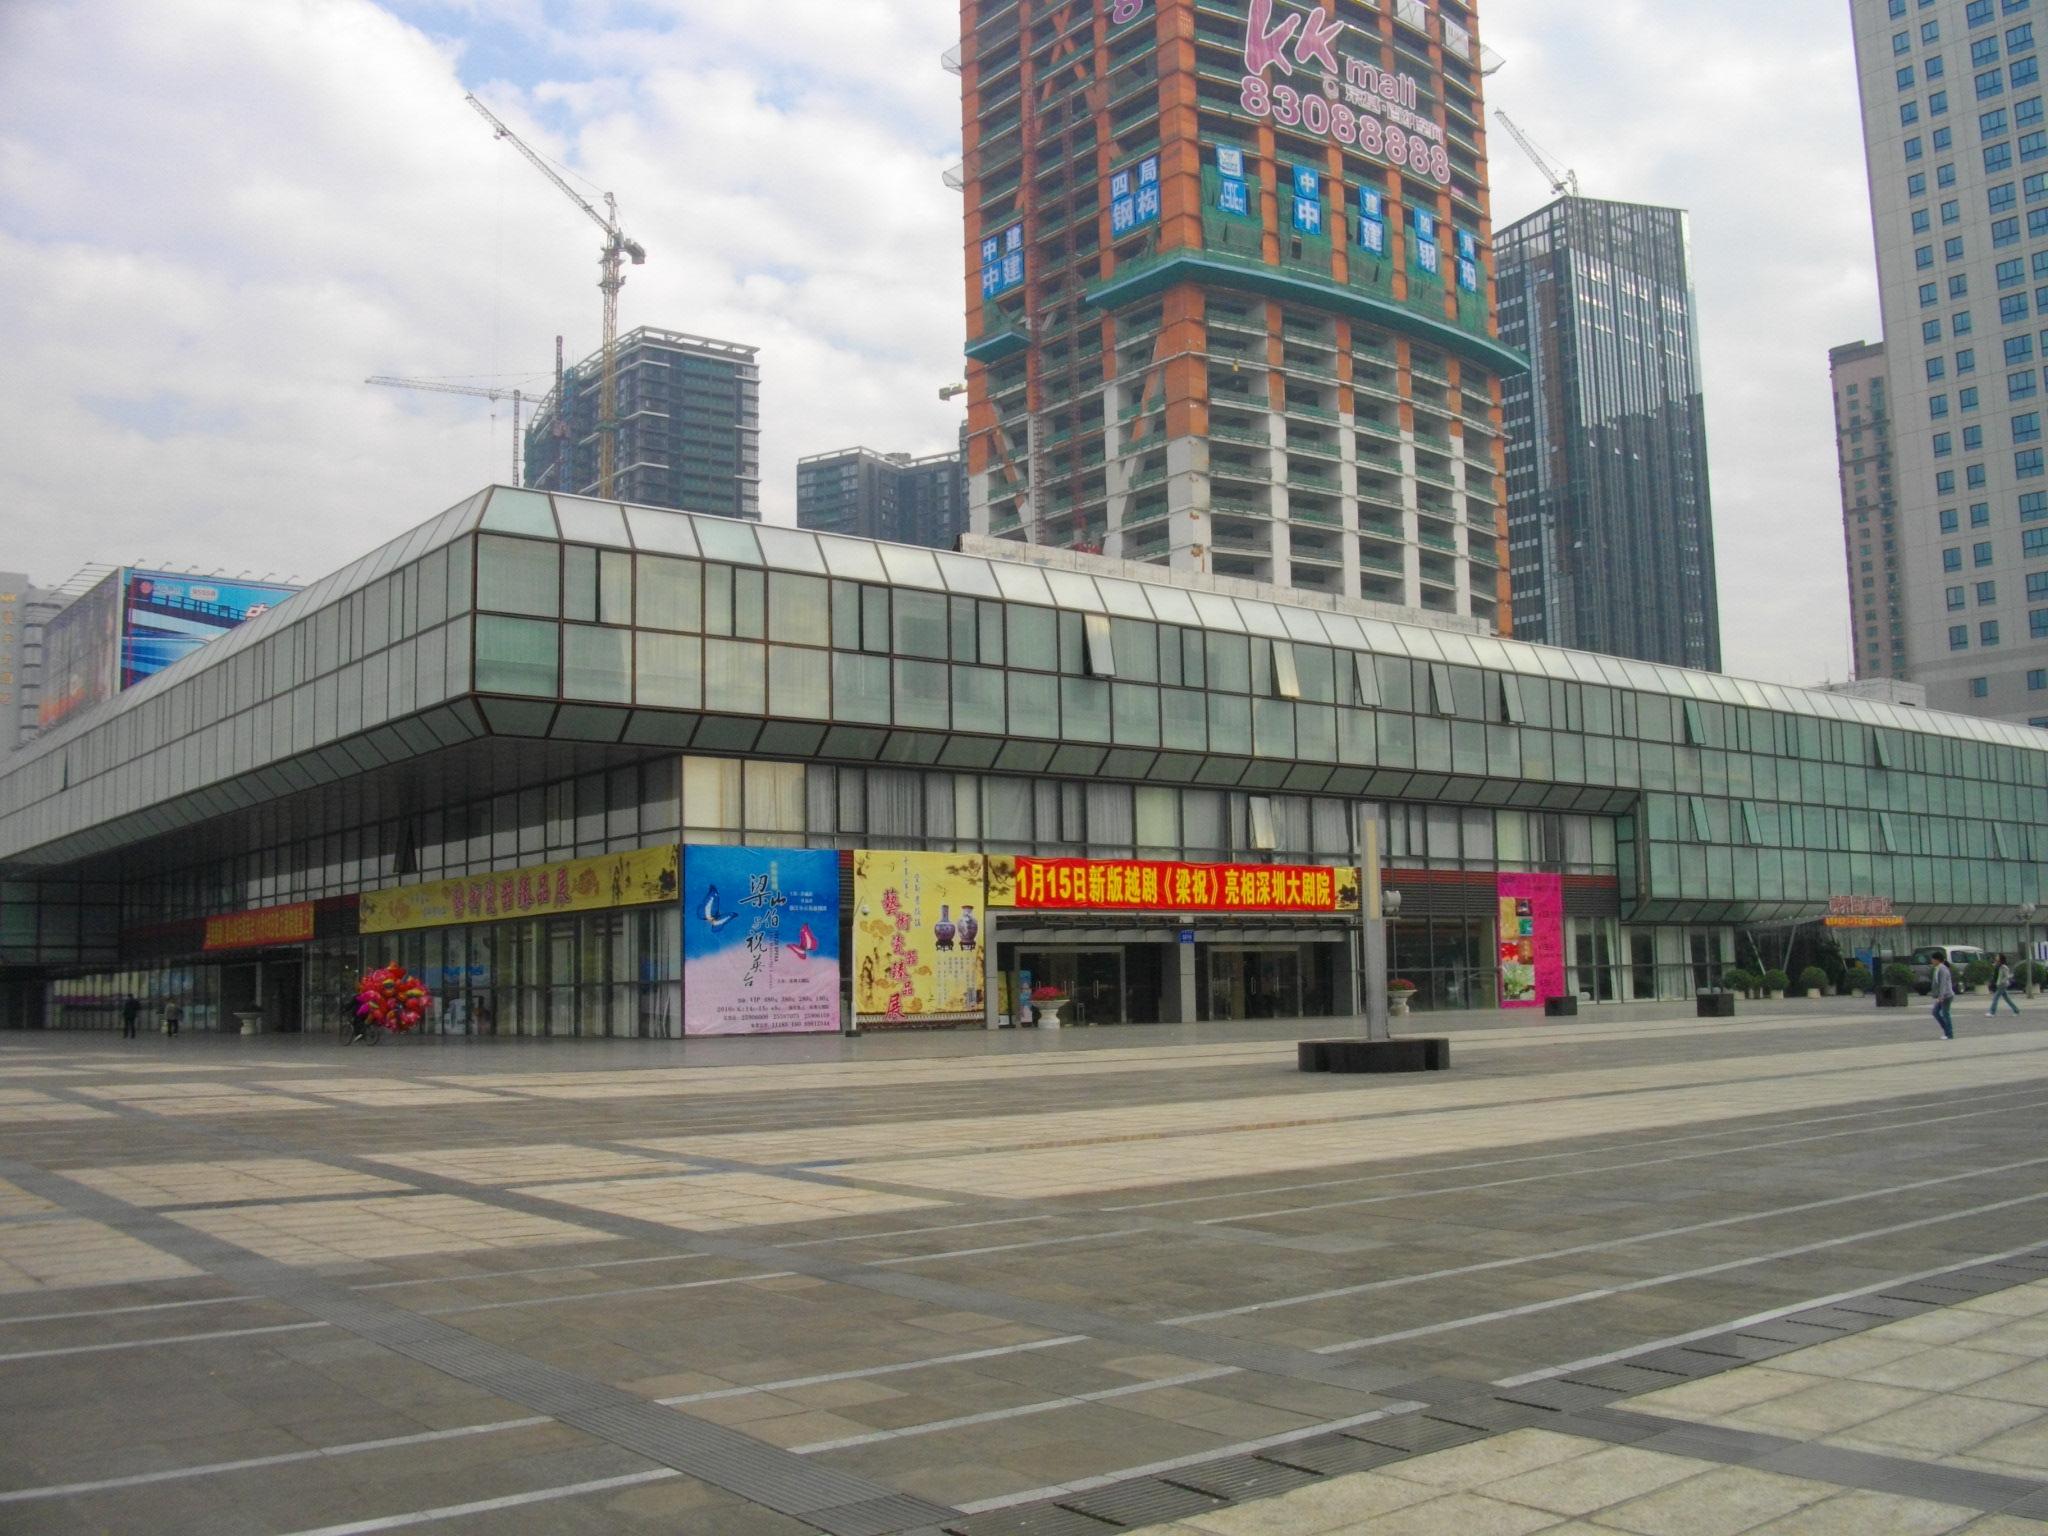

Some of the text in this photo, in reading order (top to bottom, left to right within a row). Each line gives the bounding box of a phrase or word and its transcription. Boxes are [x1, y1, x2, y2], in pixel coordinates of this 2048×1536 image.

[1345, 56, 1417, 110] mall
[1240, 75, 1451, 184] 83088888
[1016, 863, 1331, 906] 1月15日新版越剧《梁祝》亮相深圳大剧院
